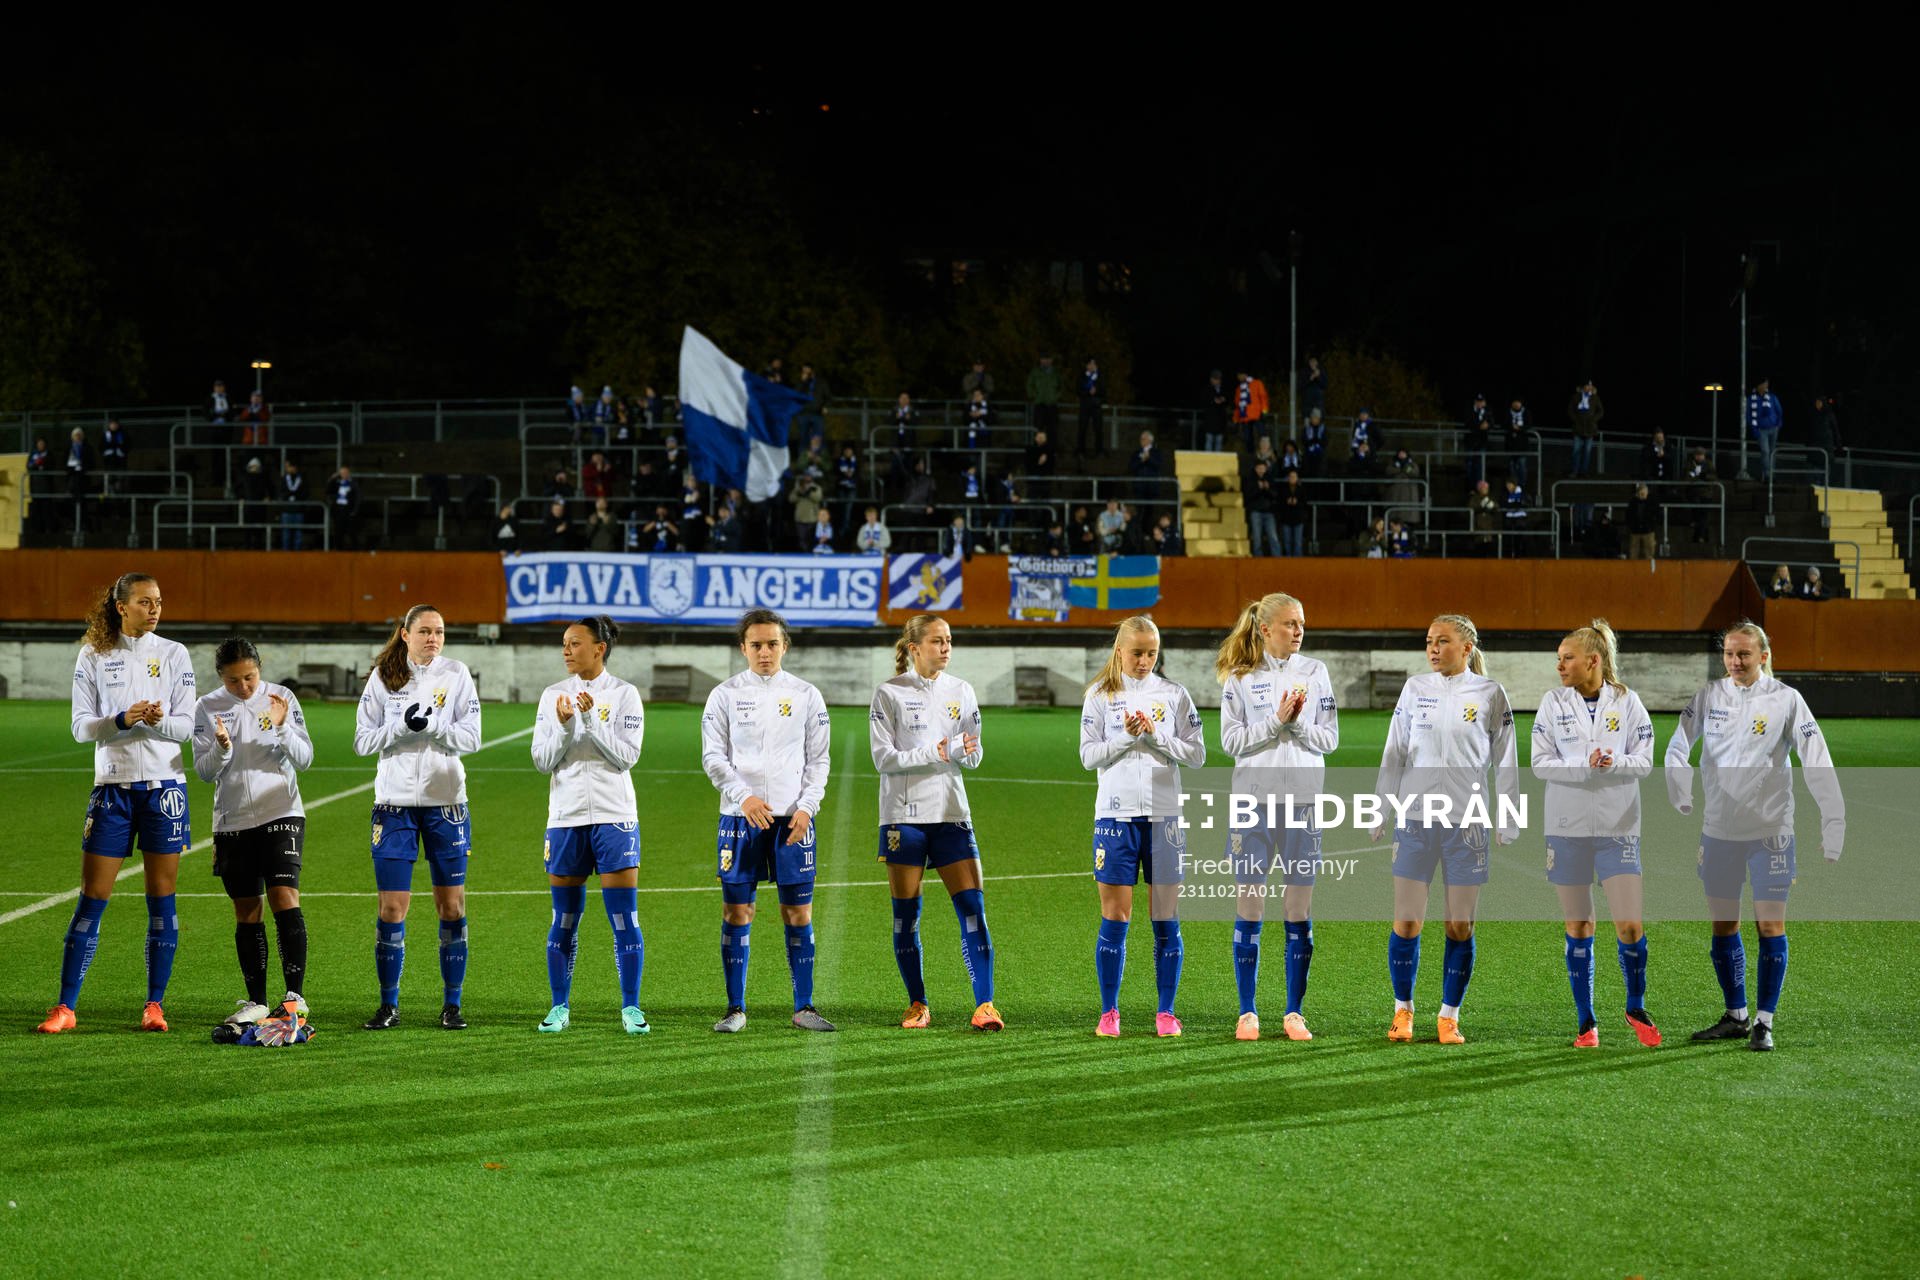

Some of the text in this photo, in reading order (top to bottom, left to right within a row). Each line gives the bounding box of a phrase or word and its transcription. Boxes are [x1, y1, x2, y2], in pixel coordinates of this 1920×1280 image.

[510, 563, 641, 606] CLAVA
[703, 566, 877, 609] ANGELIS
[161, 789, 185, 818] MG
[171, 822, 183, 836] 14
[267, 823, 300, 833] BRIXLY
[803, 851, 814, 865] 10
[1770, 855, 1787, 869] 24
